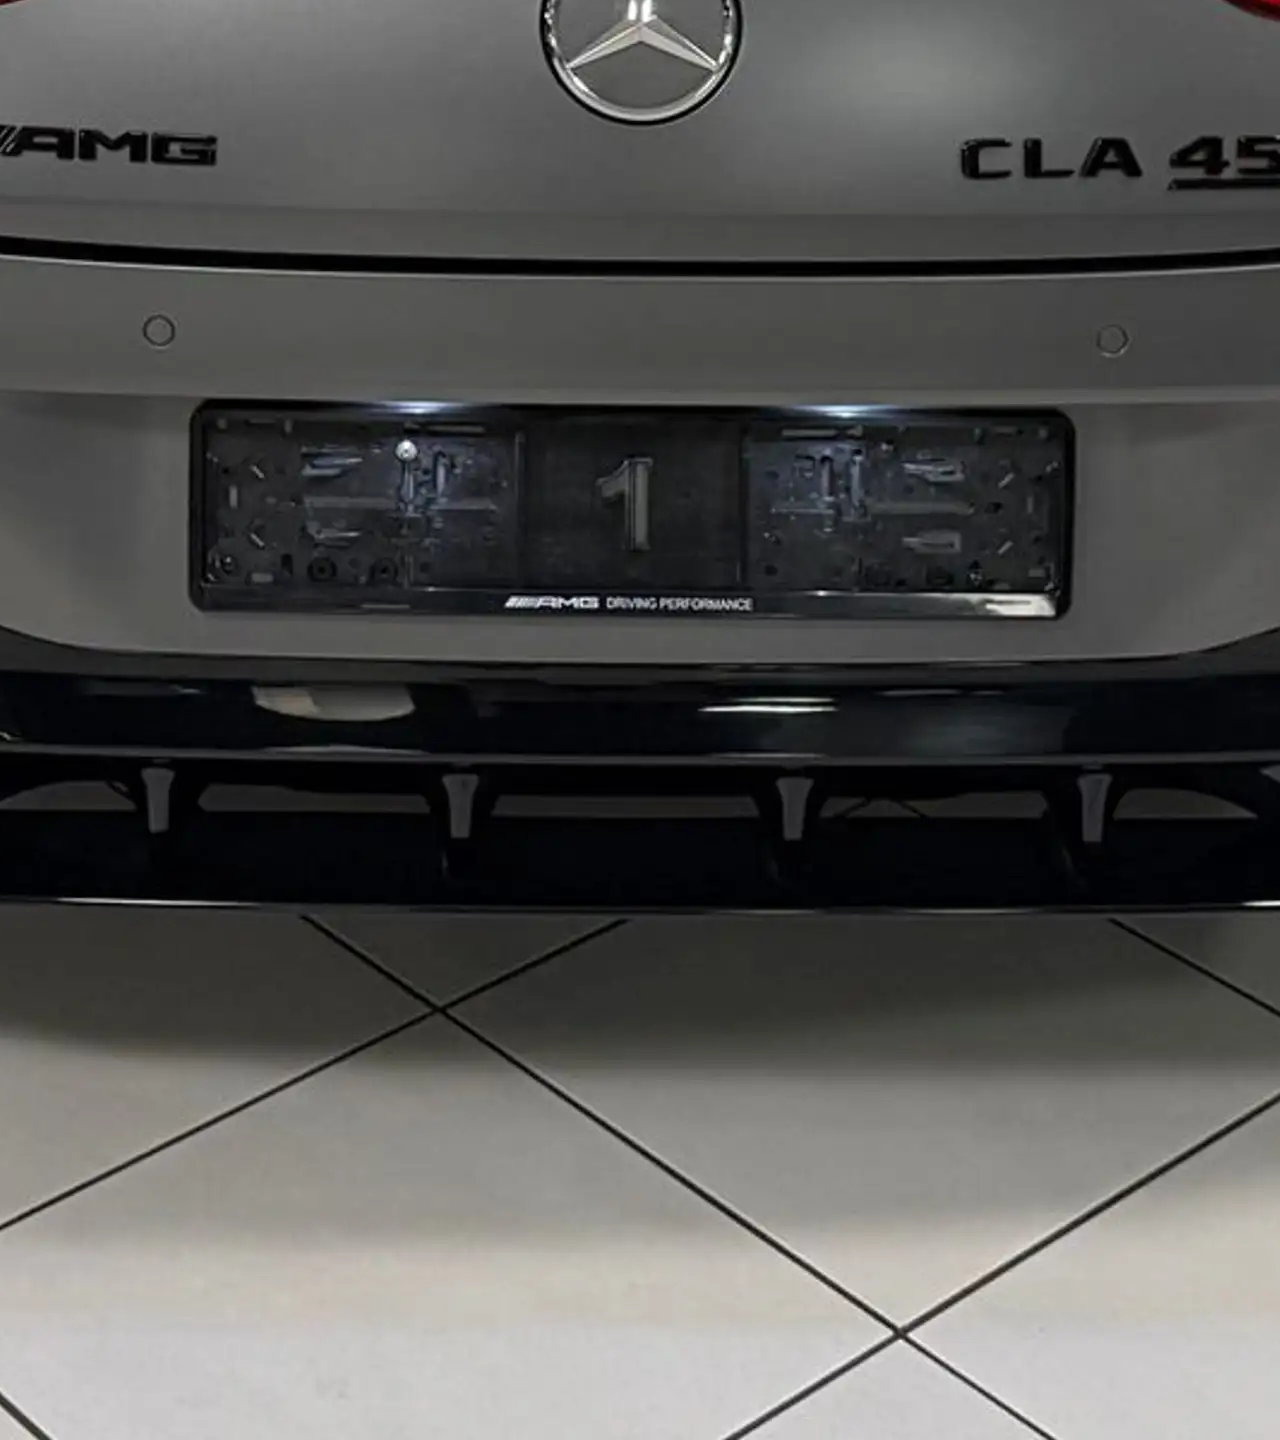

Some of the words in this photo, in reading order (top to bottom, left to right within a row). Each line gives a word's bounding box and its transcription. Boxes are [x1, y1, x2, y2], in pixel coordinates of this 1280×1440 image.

[0, 125, 218, 166] AMG
[960, 136, 1143, 180] CLA
[534, 595, 599, 609] AMG
[606, 596, 657, 610] DRIVING
[659, 596, 754, 611] PERFORMANCE
